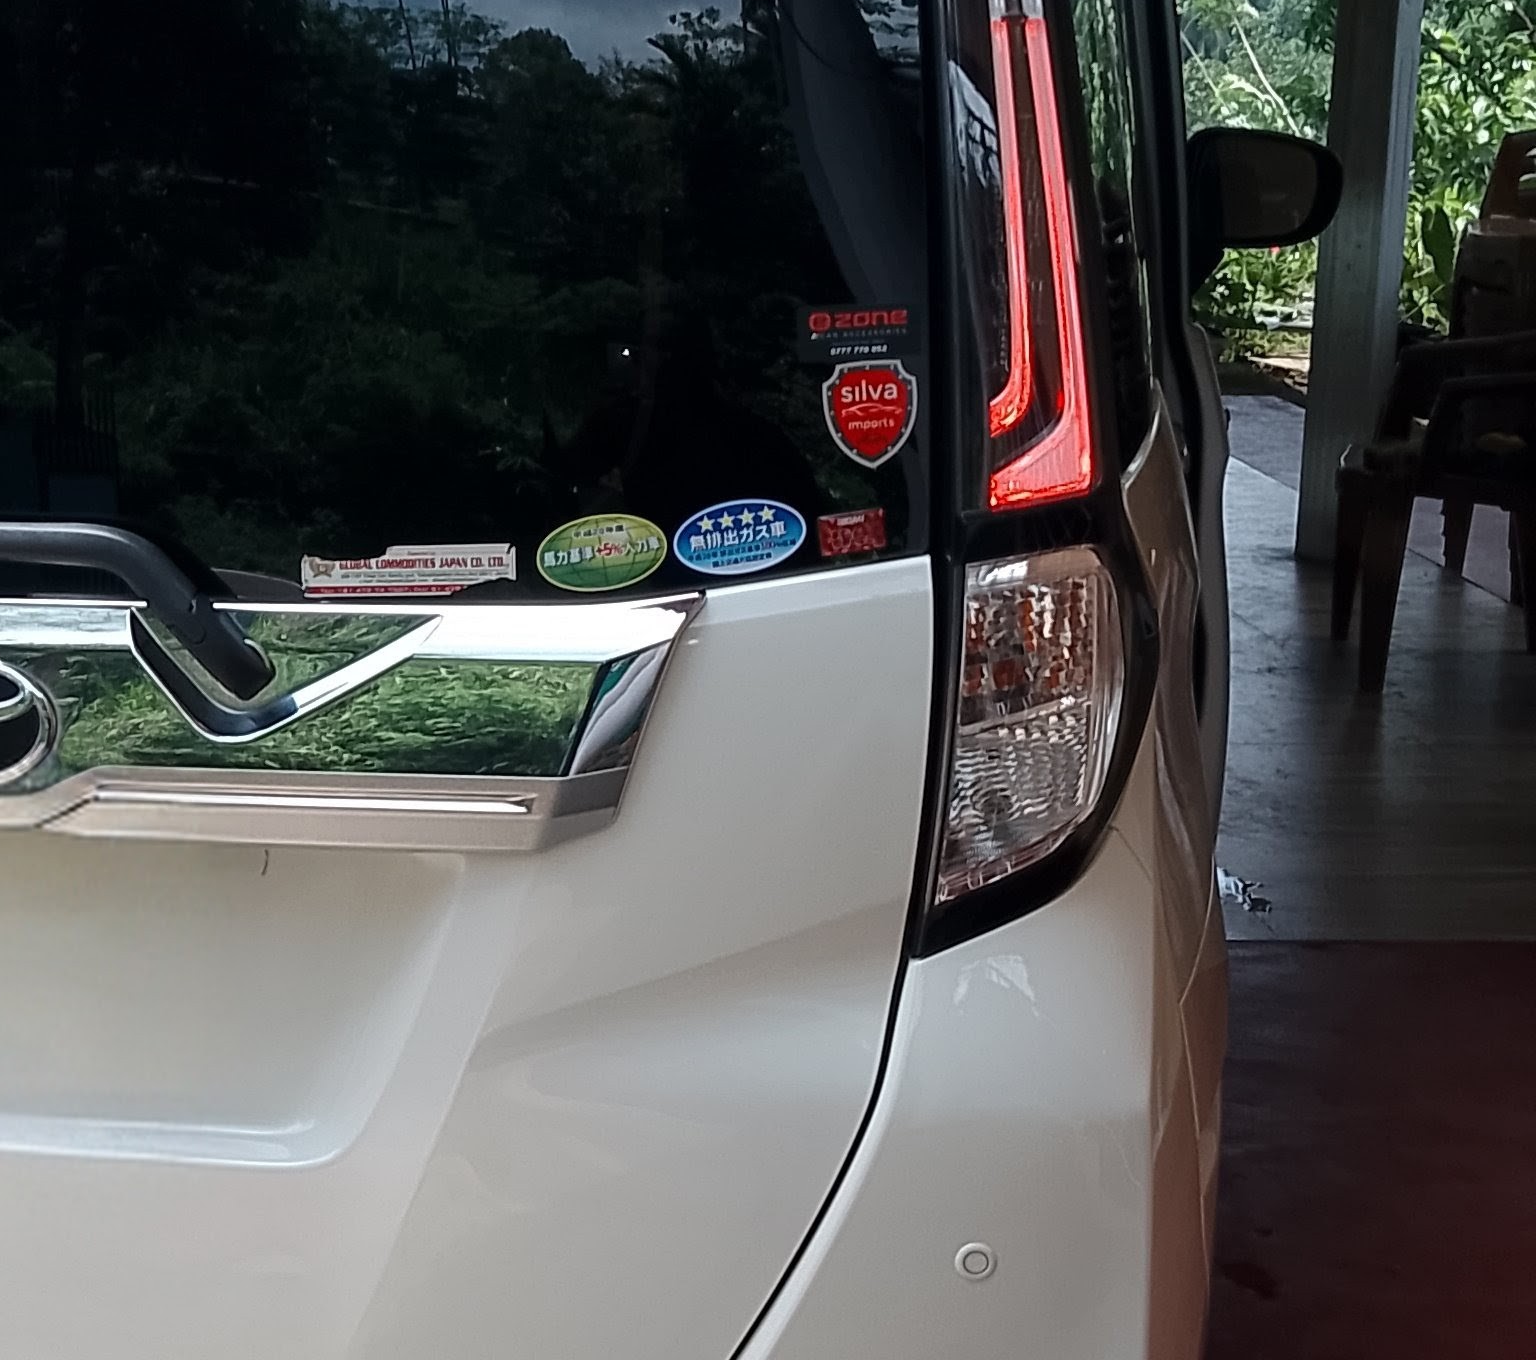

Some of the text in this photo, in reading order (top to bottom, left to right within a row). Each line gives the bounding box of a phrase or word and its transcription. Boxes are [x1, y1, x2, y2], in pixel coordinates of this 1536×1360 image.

[840, 379, 898, 403] silva
[848, 417, 895, 432] imports
[438, 556, 468, 569] JAPAN
